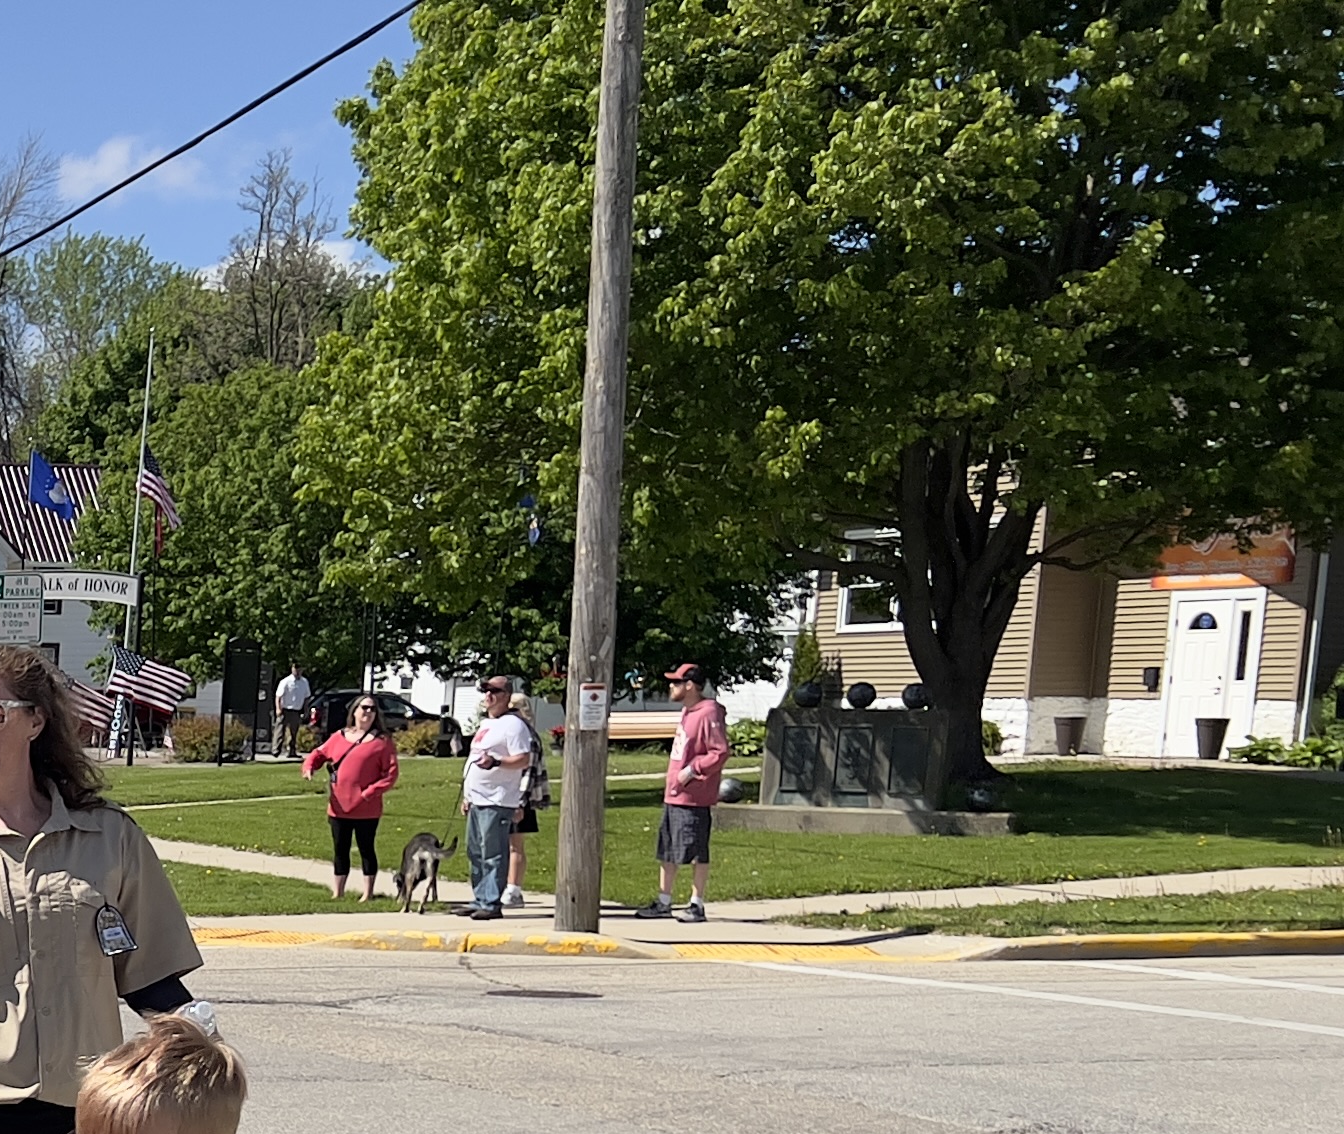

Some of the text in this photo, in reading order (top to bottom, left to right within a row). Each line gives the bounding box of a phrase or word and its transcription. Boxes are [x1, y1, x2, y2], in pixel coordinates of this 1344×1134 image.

[5, 588, 40, 597] PARKING
[68, 577, 79, 590] of
[84, 578, 129, 596] HONOR
